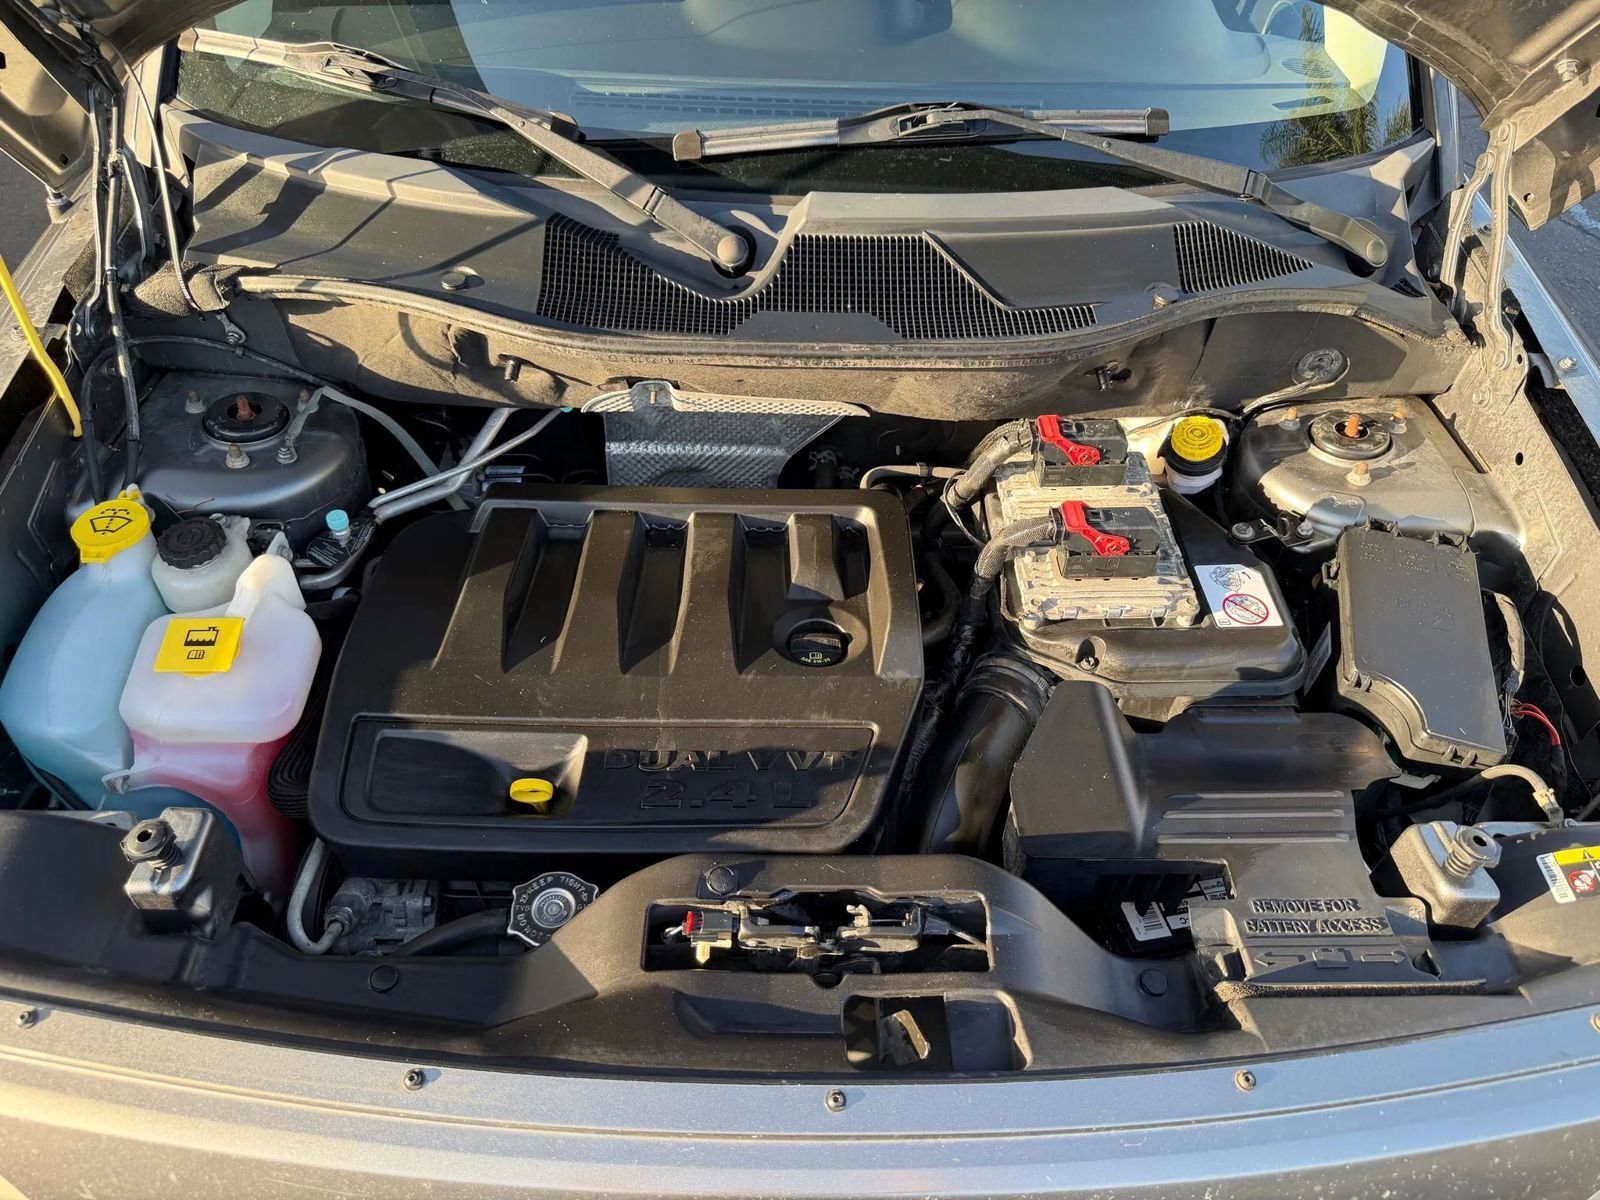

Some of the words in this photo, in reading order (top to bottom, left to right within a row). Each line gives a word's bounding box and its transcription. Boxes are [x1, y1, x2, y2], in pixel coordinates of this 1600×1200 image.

[604, 749, 736, 771] DUAL
[747, 750, 854, 771] VVT
[1250, 899, 1318, 914] REMOVE
[1321, 899, 1357, 914] FOR
[1244, 918, 1313, 934] BATTERY
[1318, 918, 1384, 934] ACCESS
